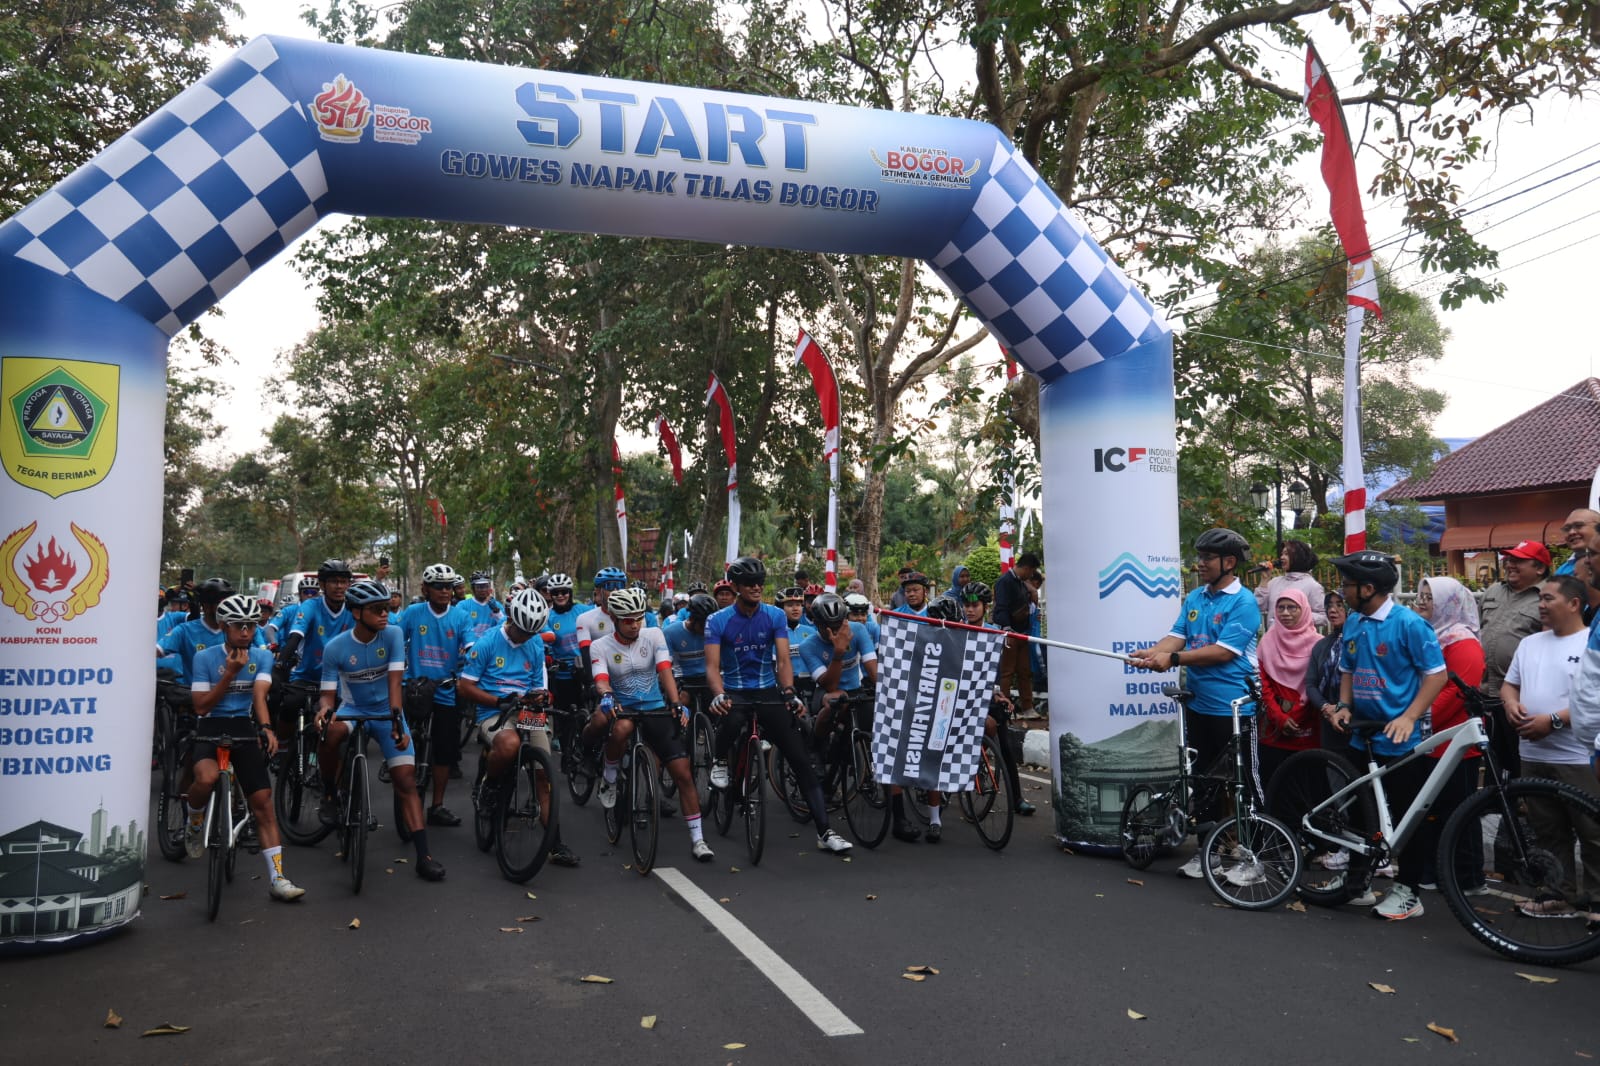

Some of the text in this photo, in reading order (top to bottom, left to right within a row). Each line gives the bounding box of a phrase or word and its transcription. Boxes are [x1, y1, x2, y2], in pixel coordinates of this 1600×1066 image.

[375, 114, 430, 131] BOGOR
[515, 82, 818, 171] START
[900, 146, 947, 156] KABUPATEN
[887, 151, 964, 176] BOGOR
[440, 149, 880, 213] GOWES NAPAK TILAS BOGOR
[881, 169, 921, 180] ISTIMEWA
[930, 174, 970, 184] GEMILANG
[23, 388, 47, 421] PRAYOGA
[72, 390, 93, 420] TOHAGA
[41, 431, 73, 439] SAYAGA
[16, 464, 97, 480] TEGAR BERIMAN
[0, 637, 98, 645] KABUPATEN BOGOR
[0, 697, 98, 716] BUPATI
[0, 726, 94, 746] BOGOR
[0, 754, 112, 776] BINONG
